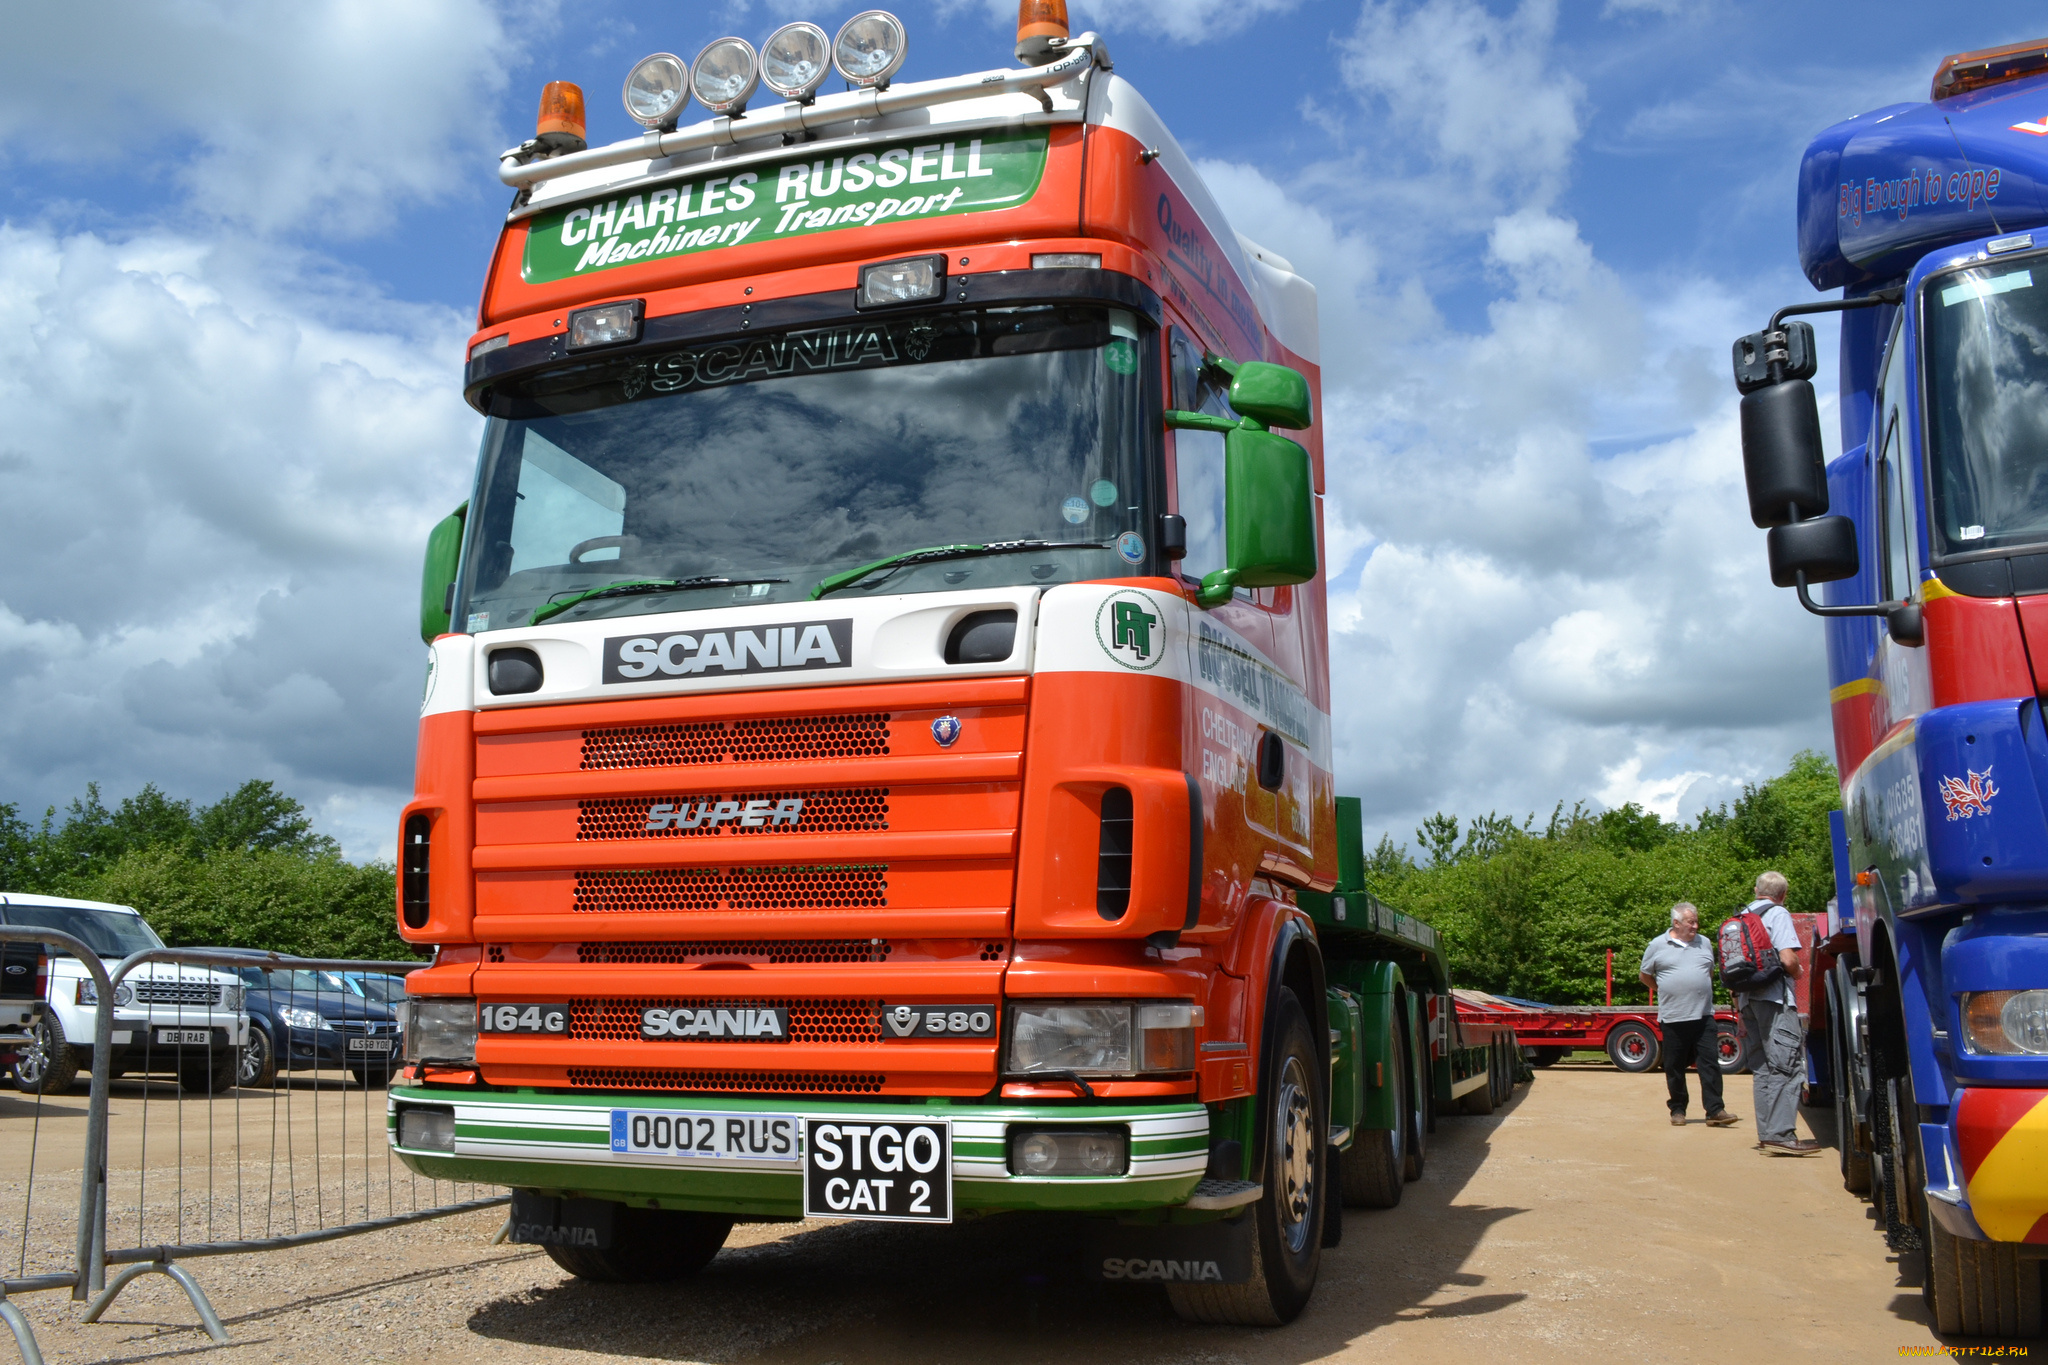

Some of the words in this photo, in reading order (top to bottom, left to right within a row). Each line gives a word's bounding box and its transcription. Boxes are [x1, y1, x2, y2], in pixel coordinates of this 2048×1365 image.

[561, 172, 758, 247] CHARLES
[775, 139, 993, 203] RUSSELL
[1840, 180, 1862, 228] Big
[1865, 168, 1920, 221] Enough
[1924, 168, 1941, 205] to
[1946, 168, 2000, 212] cope
[574, 217, 761, 271] Machinery
[774, 186, 963, 233] Transport
[1157, 193, 1212, 294] Quality
[1217, 264, 1228, 300] in
[652, 325, 898, 391] SCANIA
[618, 624, 841, 678] SCANIA
[646, 799, 803, 830] SUPER
[1887, 774, 1914, 819] 01685
[187, 1033, 205, 1042] RAB
[643, 1009, 782, 1036] SCANIA
[926, 1012, 991, 1032] 580
[613, 1138, 626, 1147] GB
[726, 1119, 791, 1154] RUS
[814, 1124, 941, 1173] STGO
[825, 1177, 894, 1212] CAT
[909, 1180, 931, 1213] 2
[518, 1222, 598, 1247] SCANIA
[1102, 1258, 1223, 1281] SCANIA
